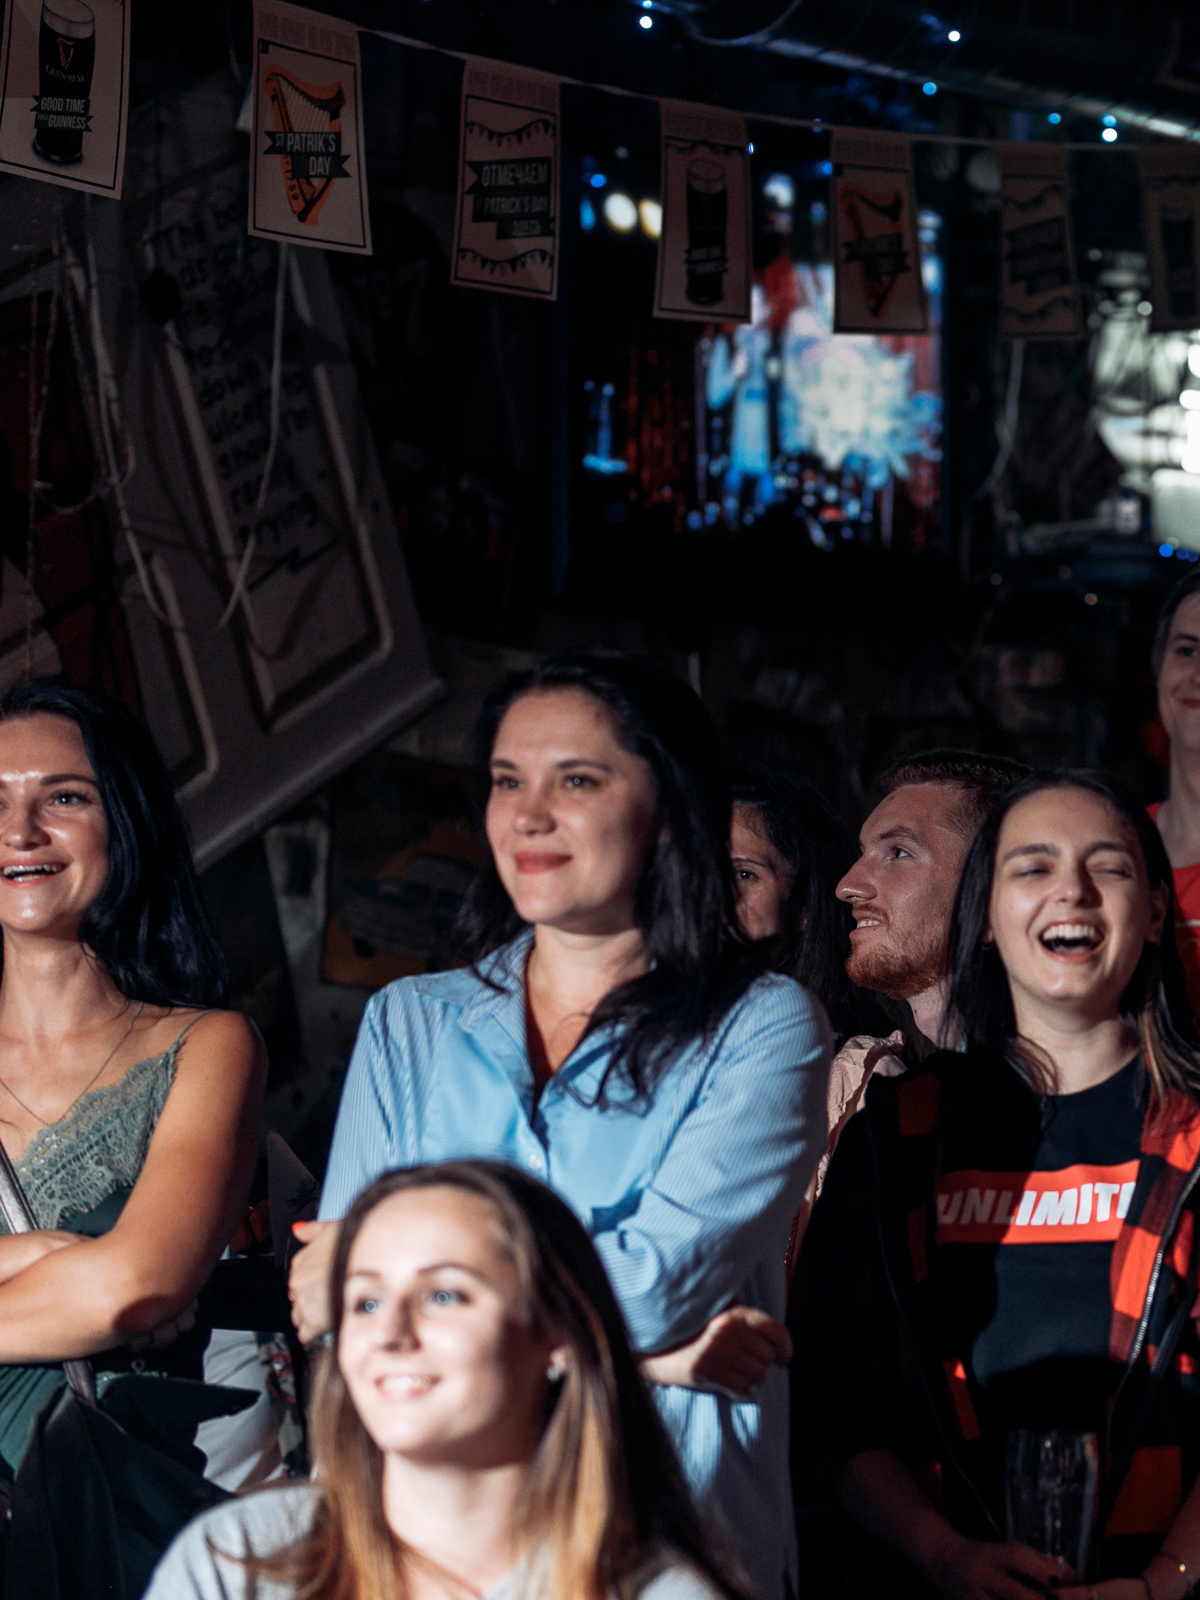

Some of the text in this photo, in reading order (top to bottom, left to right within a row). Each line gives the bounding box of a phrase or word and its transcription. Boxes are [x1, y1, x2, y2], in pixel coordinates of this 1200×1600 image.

[45, 64, 85, 83] GUINNESS
[40, 96, 86, 113] GOOD TIME
[47, 114, 87, 130] GUINNESS
[275, 132, 336, 153] ST PATRIK'S
[309, 155, 332, 176] DAY
